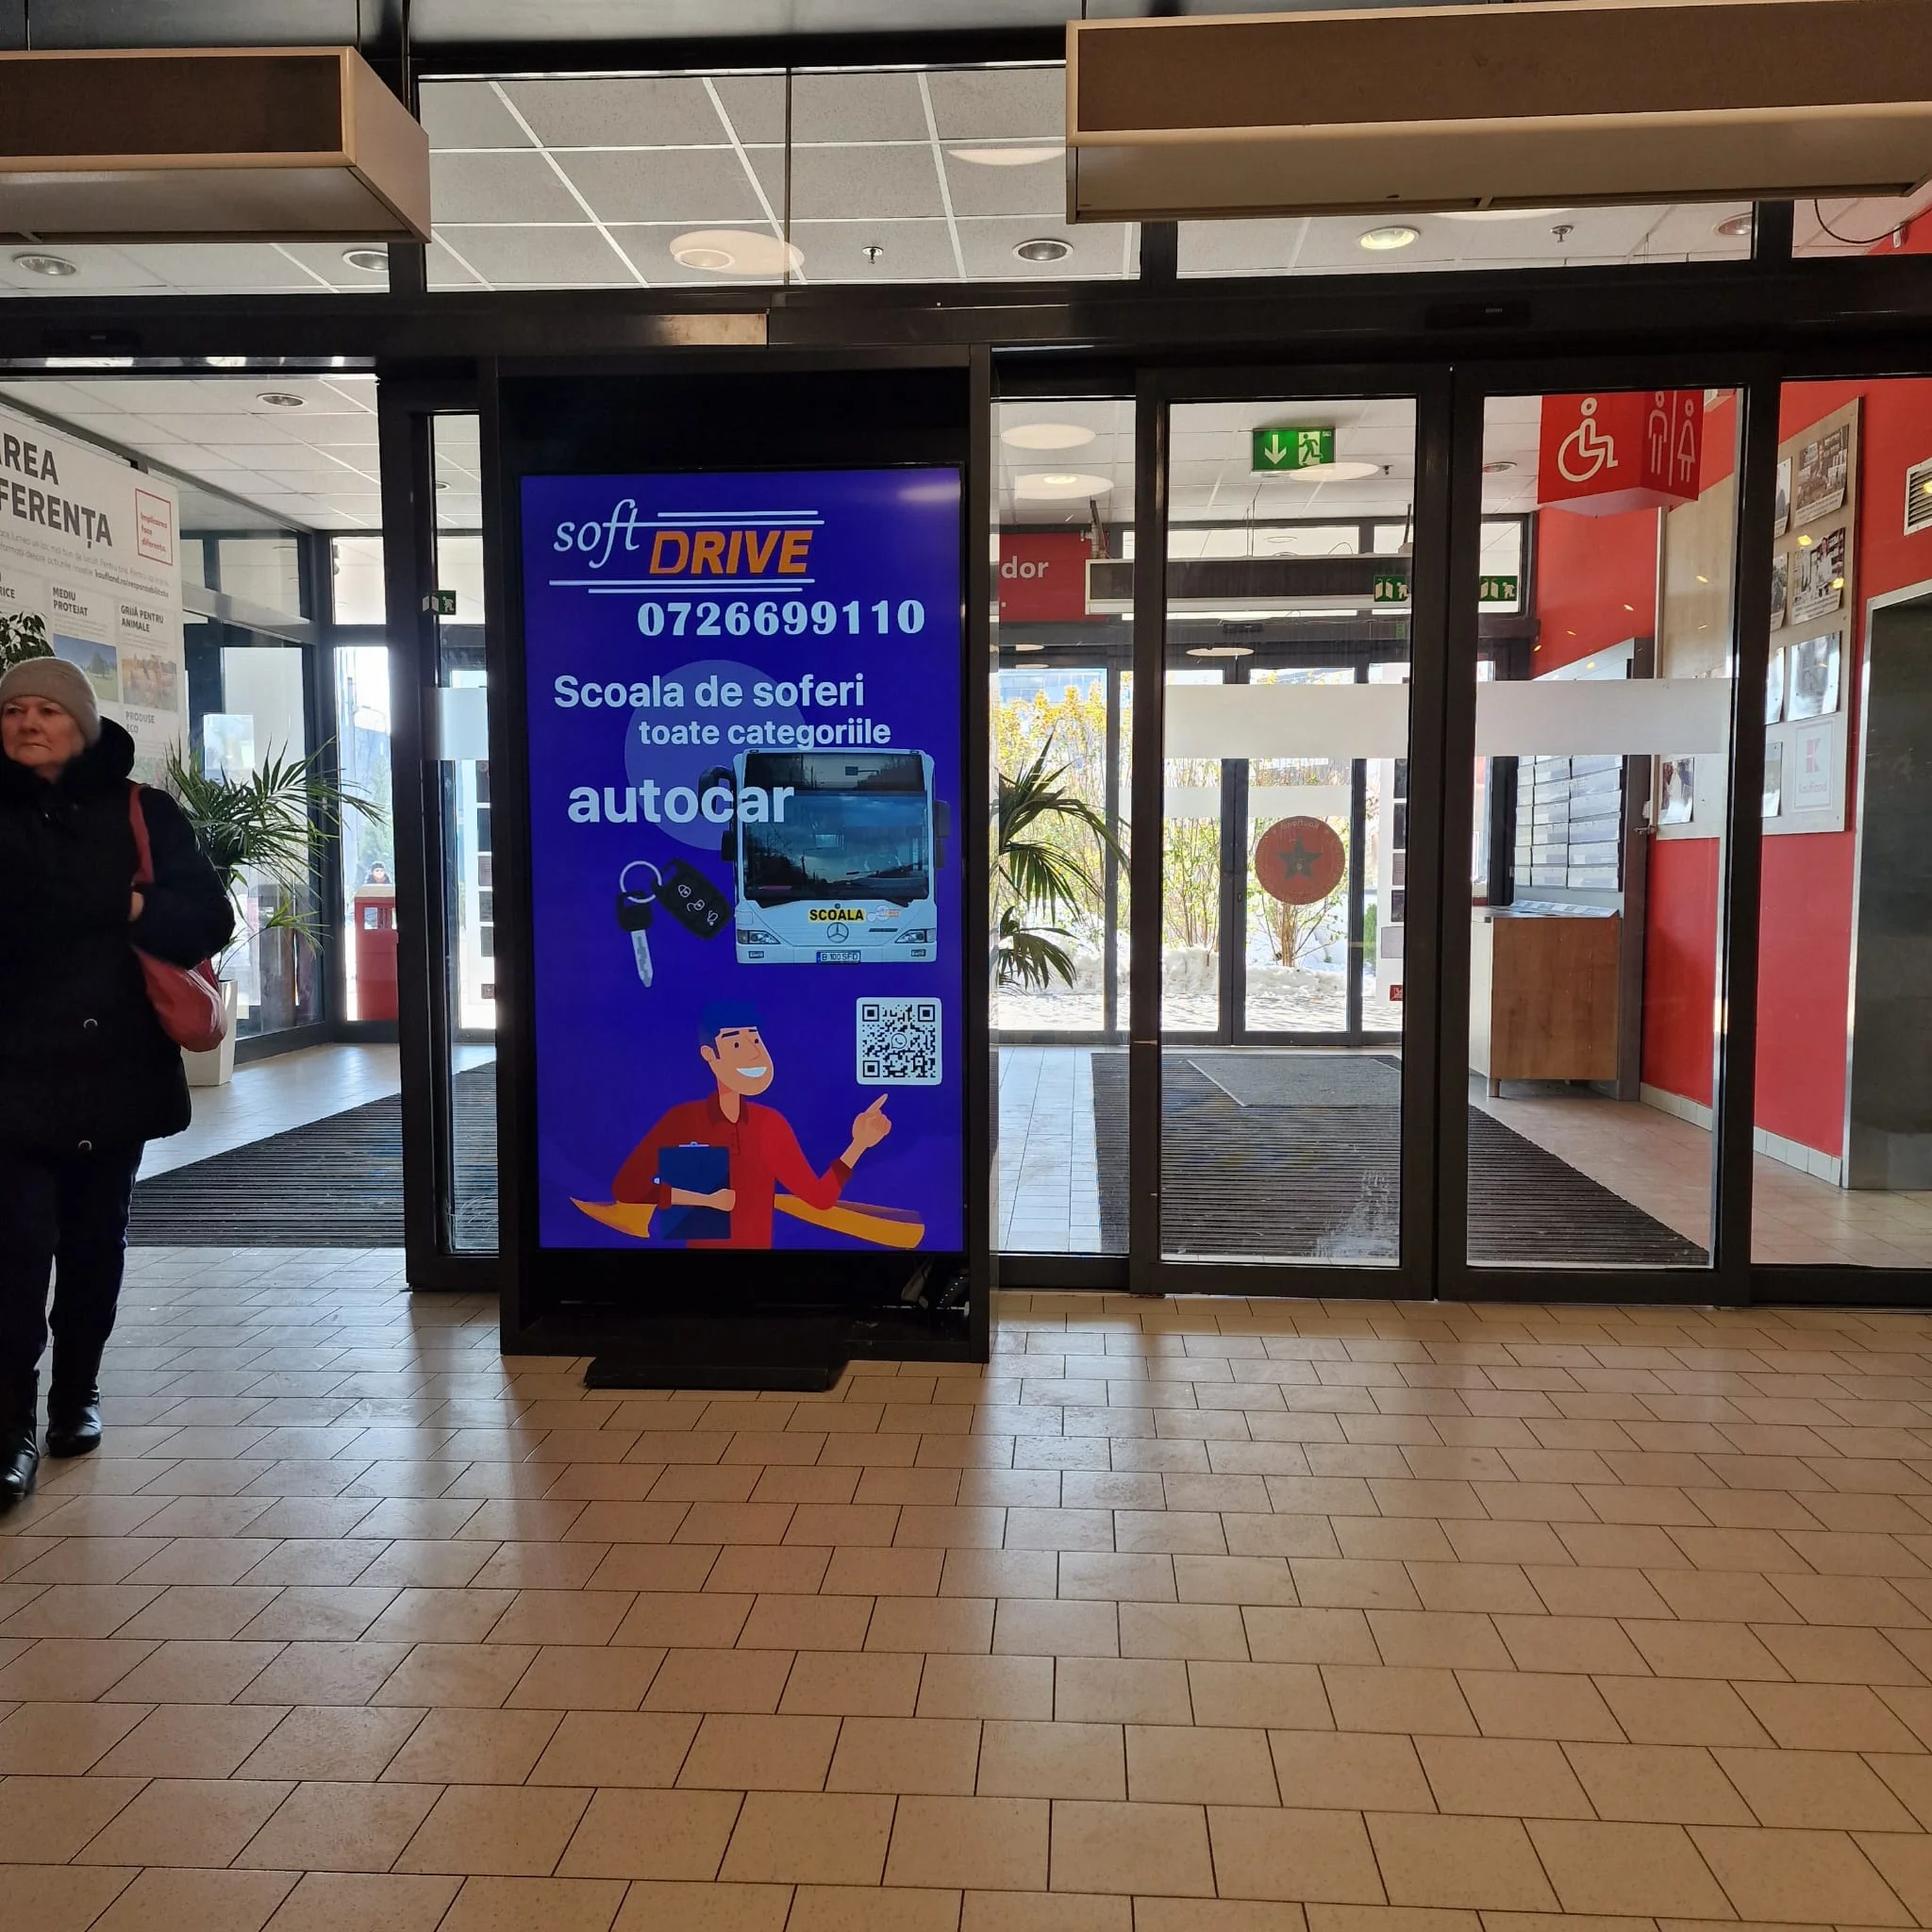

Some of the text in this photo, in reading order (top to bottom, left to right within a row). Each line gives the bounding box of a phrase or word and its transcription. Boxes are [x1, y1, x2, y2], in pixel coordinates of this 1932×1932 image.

[0, 432, 58, 485] REA
[553, 498, 814, 575] soft DRIVE
[1001, 556, 1049, 578] dor
[52, 587, 76, 601] MEDIU
[53, 599, 88, 616] PROTEJAT
[121, 618, 150, 633] ANIMALE
[139, 609, 164, 625] PENTRU
[637, 600, 925, 636] 0726699110
[554, 674, 864, 708] Scoala de soferi
[639, 718, 891, 750] toate categoriile
[567, 778, 794, 824] autocar
[809, 908, 864, 921] SCOALA
